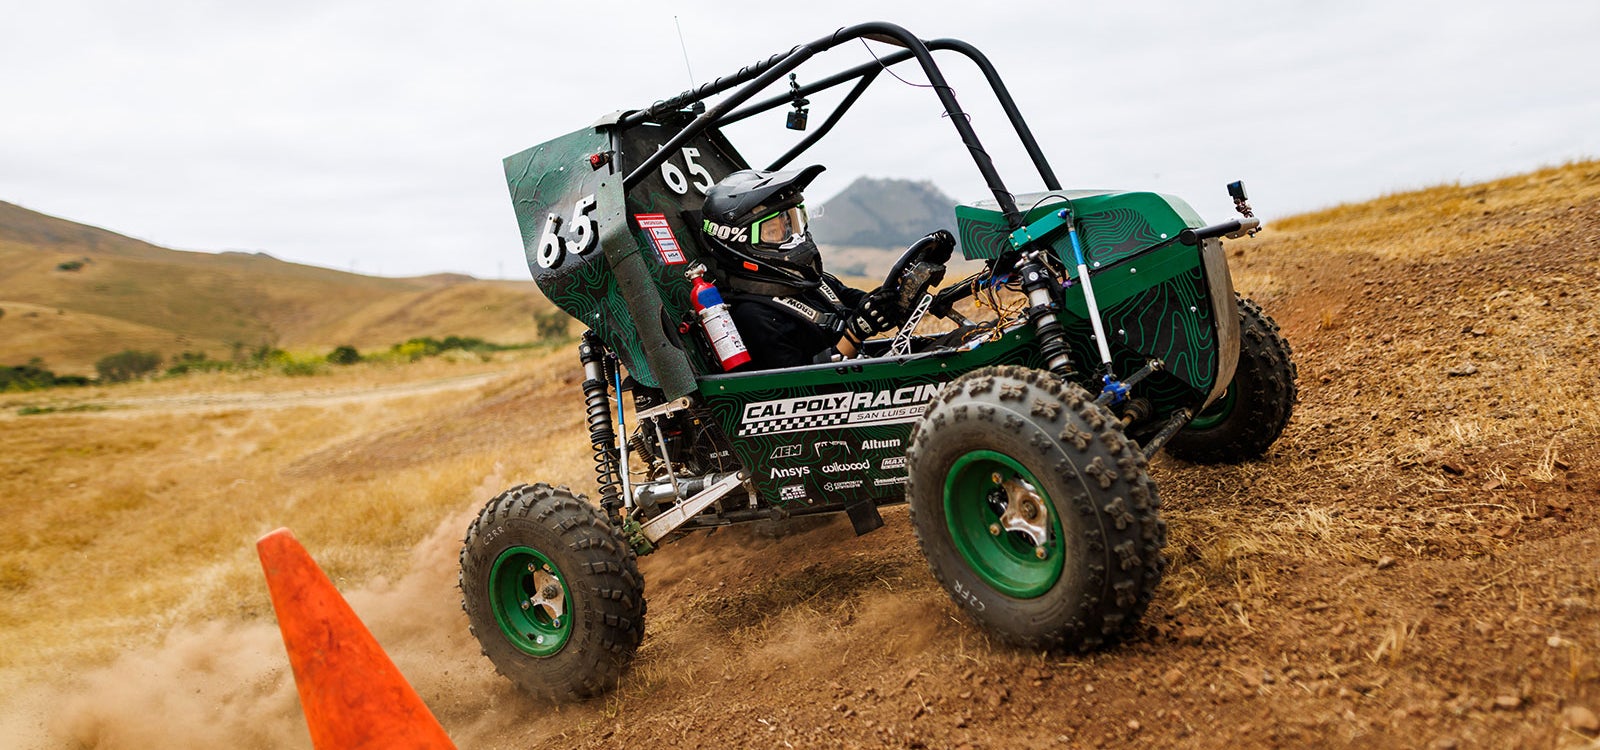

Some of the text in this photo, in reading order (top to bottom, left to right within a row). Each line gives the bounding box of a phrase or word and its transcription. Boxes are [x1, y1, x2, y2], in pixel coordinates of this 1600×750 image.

[658, 144, 714, 195] 65
[537, 194, 595, 268] 65
[703, 219, 748, 243] 100%
[786, 299, 815, 317] CROW
[746, 402, 786, 419] CAL
[792, 396, 849, 414] POLY
[856, 411, 879, 421] SAN
[882, 408, 906, 418] LUIS
[770, 444, 802, 459] AEM
[861, 438, 901, 450] Altium
[770, 466, 811, 479] Ansys
[822, 459, 871, 473] wilwood
